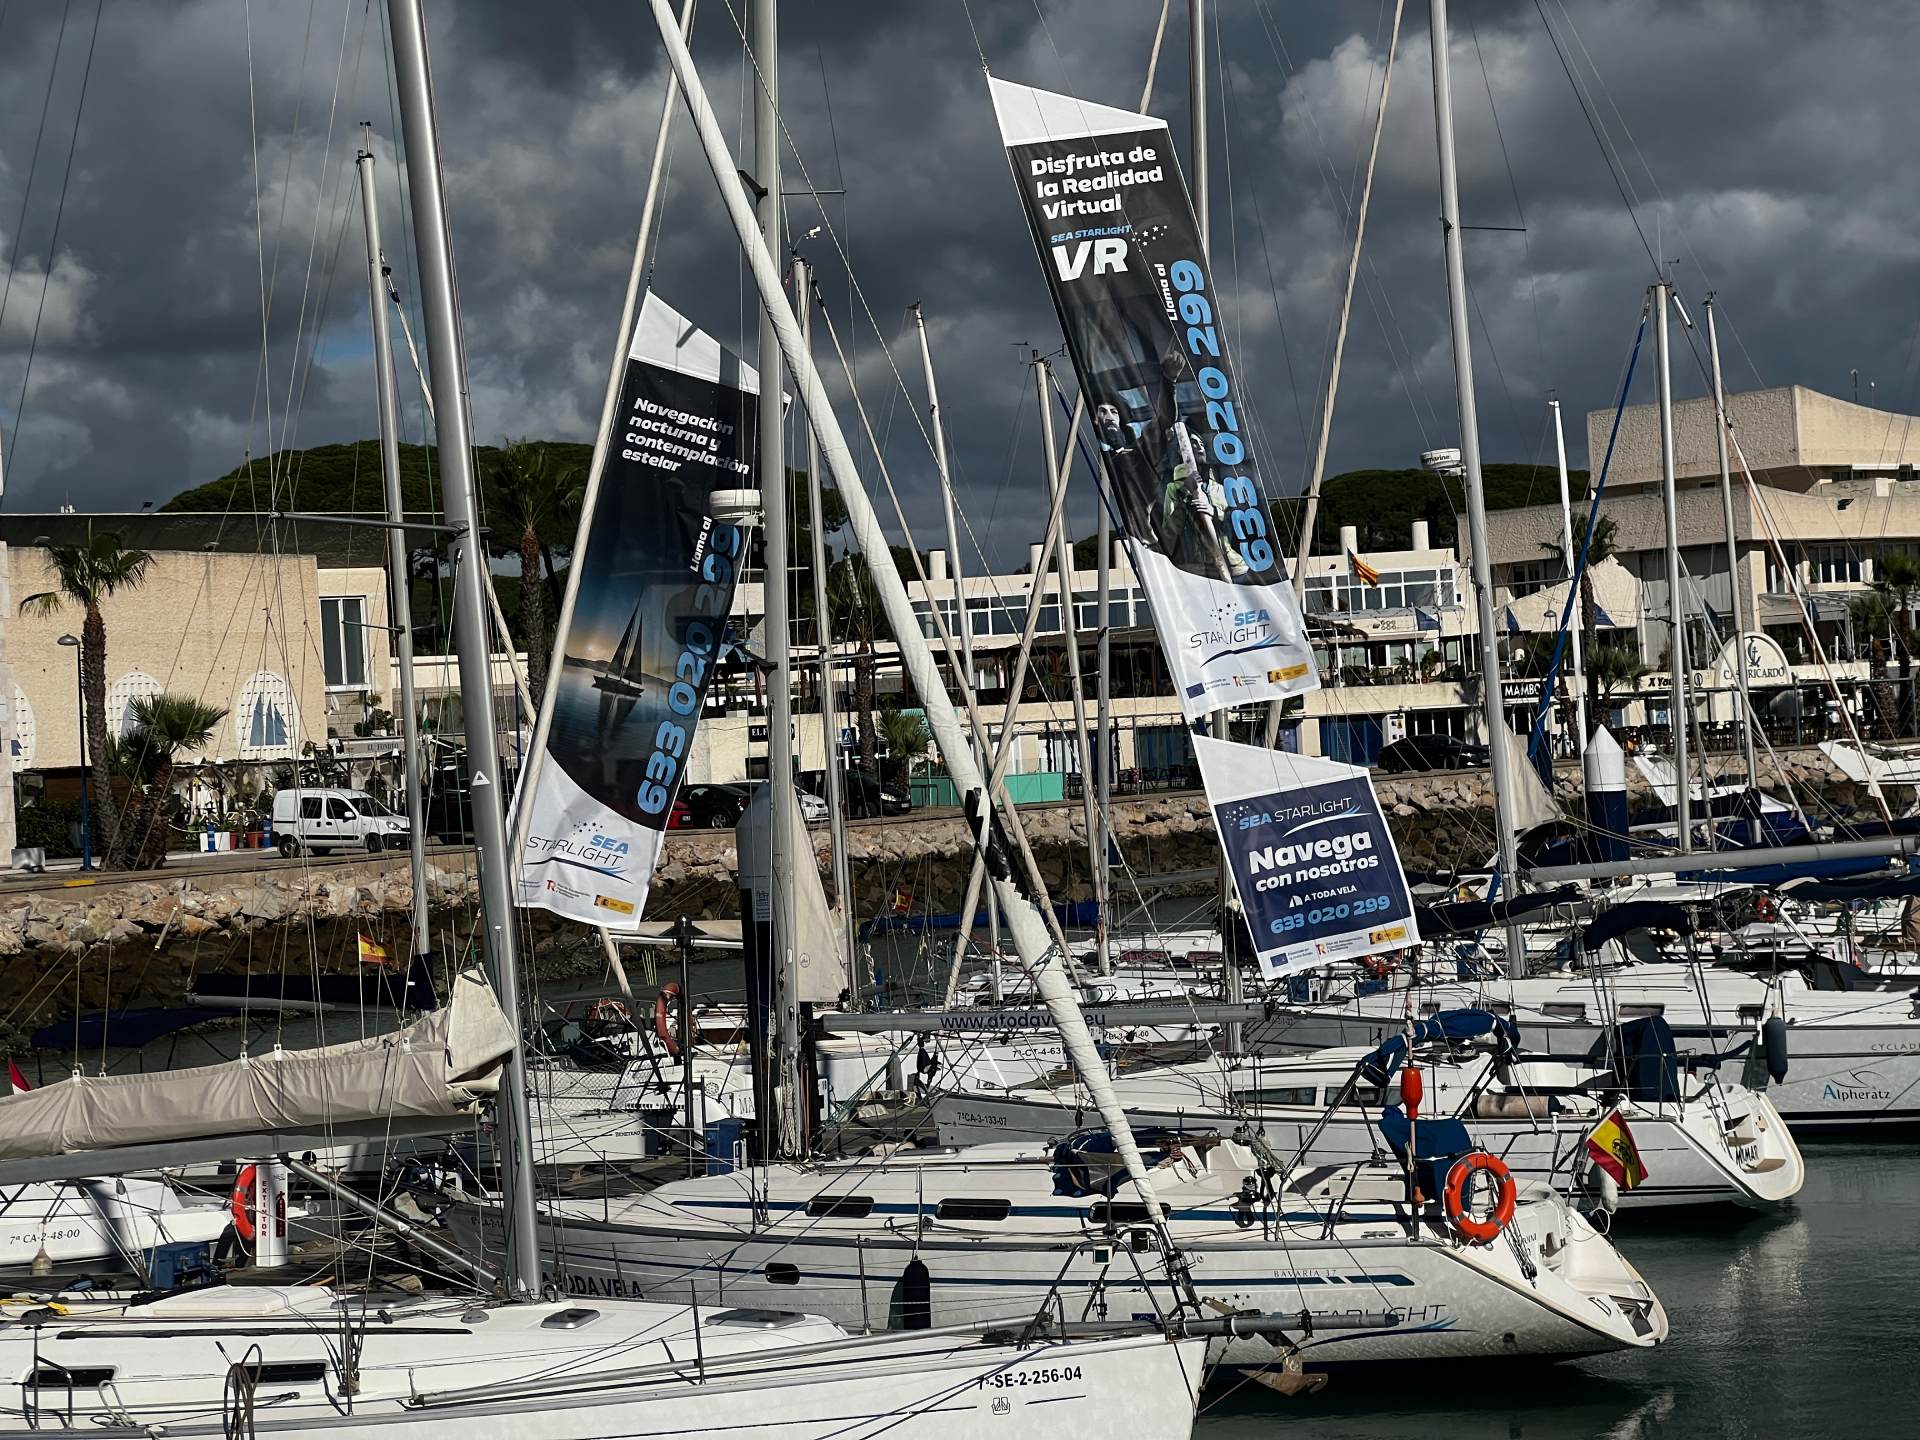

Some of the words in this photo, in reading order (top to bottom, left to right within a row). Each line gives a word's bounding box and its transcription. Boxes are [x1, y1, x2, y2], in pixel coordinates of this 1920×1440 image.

[1031, 152, 1124, 178] Disfruta
[1128, 146, 1157, 163] de
[1036, 179, 1055, 199] la
[1062, 166, 1163, 193] Realidad
[1042, 194, 1122, 220] Virtual
[1050, 231, 1073, 243] SEA
[1074, 225, 1132, 239] STARLIGHT
[1051, 238, 1129, 282] VR
[1154, 263, 1166, 277] al
[1160, 279, 1178, 321] Llama
[1170, 259, 1220, 357] 299
[634, 397, 734, 436] Navegación
[1197, 366, 1245, 466] 020
[629, 415, 707, 445] nocturna
[709, 438, 722, 451] y
[622, 448, 682, 472] estelar
[625, 432, 750, 475] contemplación
[1223, 476, 1275, 573] 633
[690, 531, 708, 573] Llama
[702, 516, 713, 531] al
[1234, 609, 1270, 627] SEA
[637, 720, 686, 815] 633
[669, 621, 714, 716] 020
[694, 524, 740, 619] 299
[1748, 667, 1784, 678] RICARDO
[1239, 813, 1272, 830] SEA
[1274, 797, 1352, 822] STARLIGHT
[526, 836, 623, 867] STARLIGHT
[590, 834, 629, 854] SEA
[1249, 831, 1372, 875] Navega
[1255, 871, 1292, 892] con
[1295, 855, 1379, 884] nosotros
[1304, 894, 1310, 903] A
[1311, 889, 1337, 901] TODA
[1336, 885, 1357, 896] VELA
[1270, 913, 1305, 934] 633
[1308, 903, 1350, 925] 020
[1353, 895, 1391, 916] 299
[940, 1012, 1106, 1029] www.atodaveu
[1823, 1084, 1891, 1102] Alpheratz
